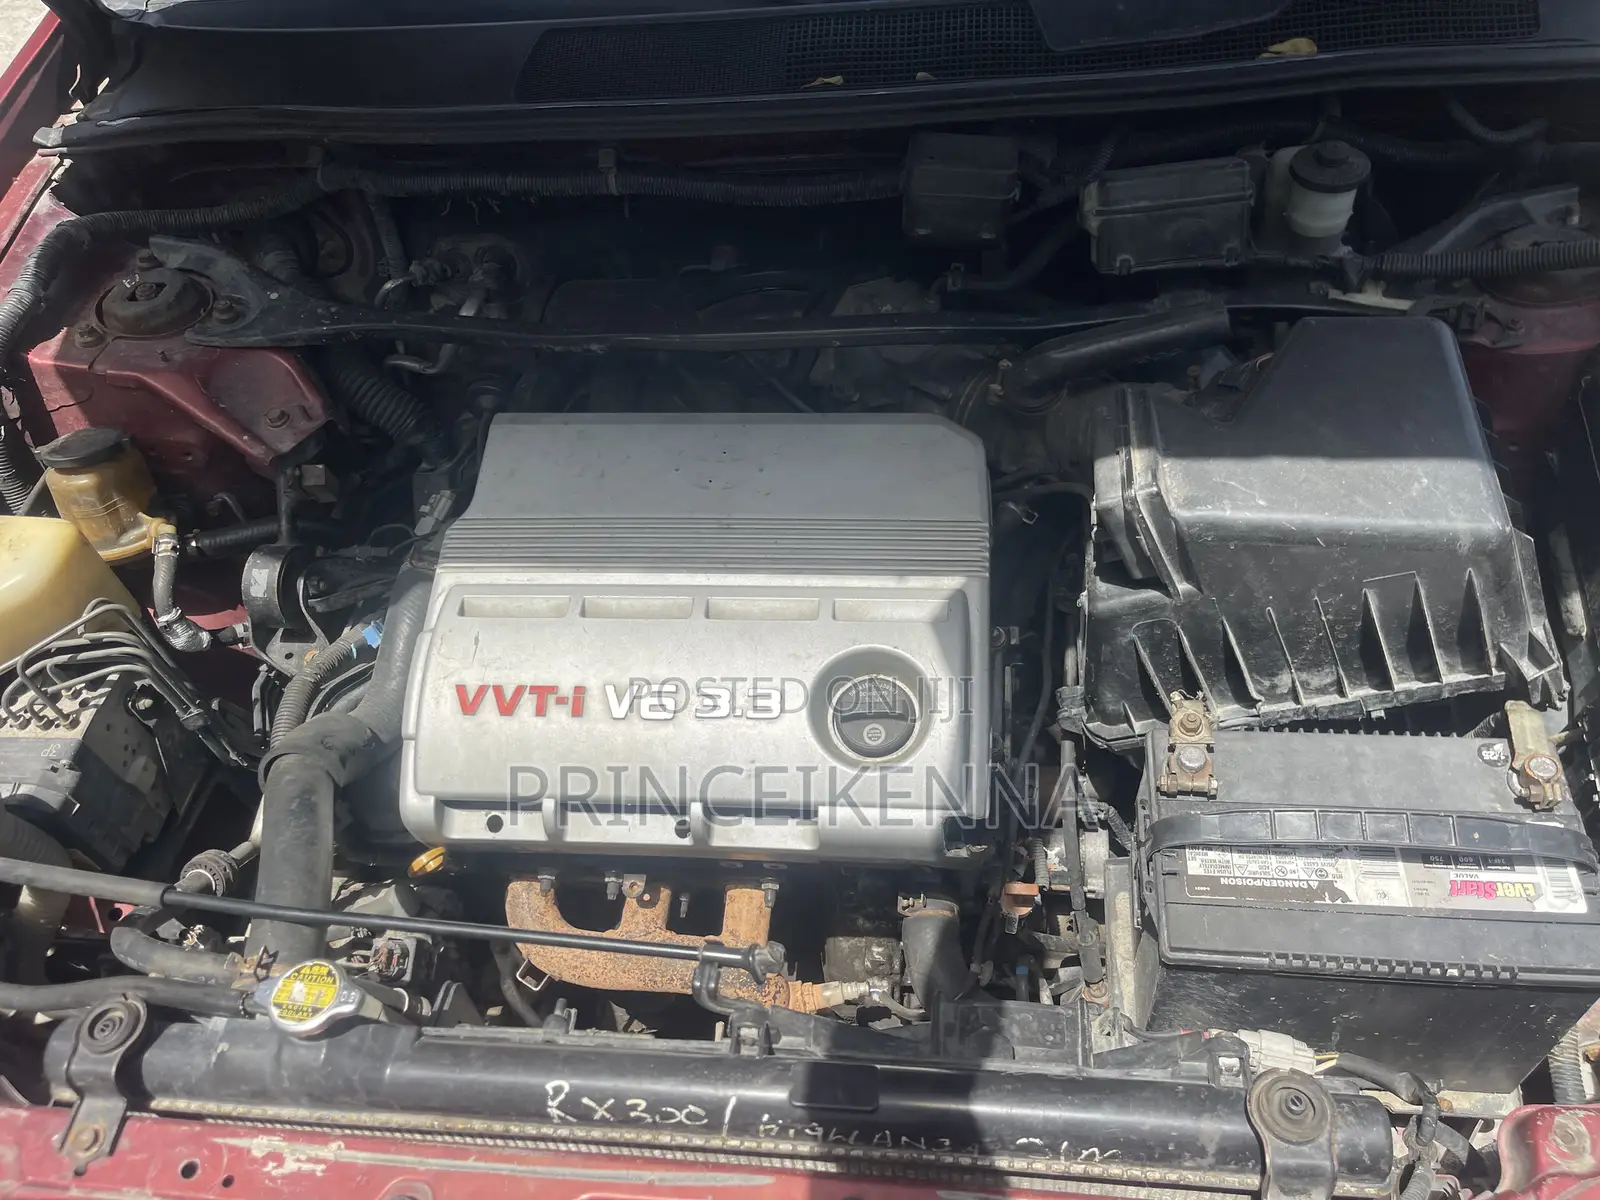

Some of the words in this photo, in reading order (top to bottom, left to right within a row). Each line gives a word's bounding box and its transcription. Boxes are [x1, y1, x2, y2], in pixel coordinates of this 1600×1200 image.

[455, 683, 587, 718] VVT-i
[604, 683, 679, 721] V6
[695, 685, 783, 720] 3.3
[1449, 880, 1536, 900] EverStart
[290, 973, 335, 985] CAUTION
